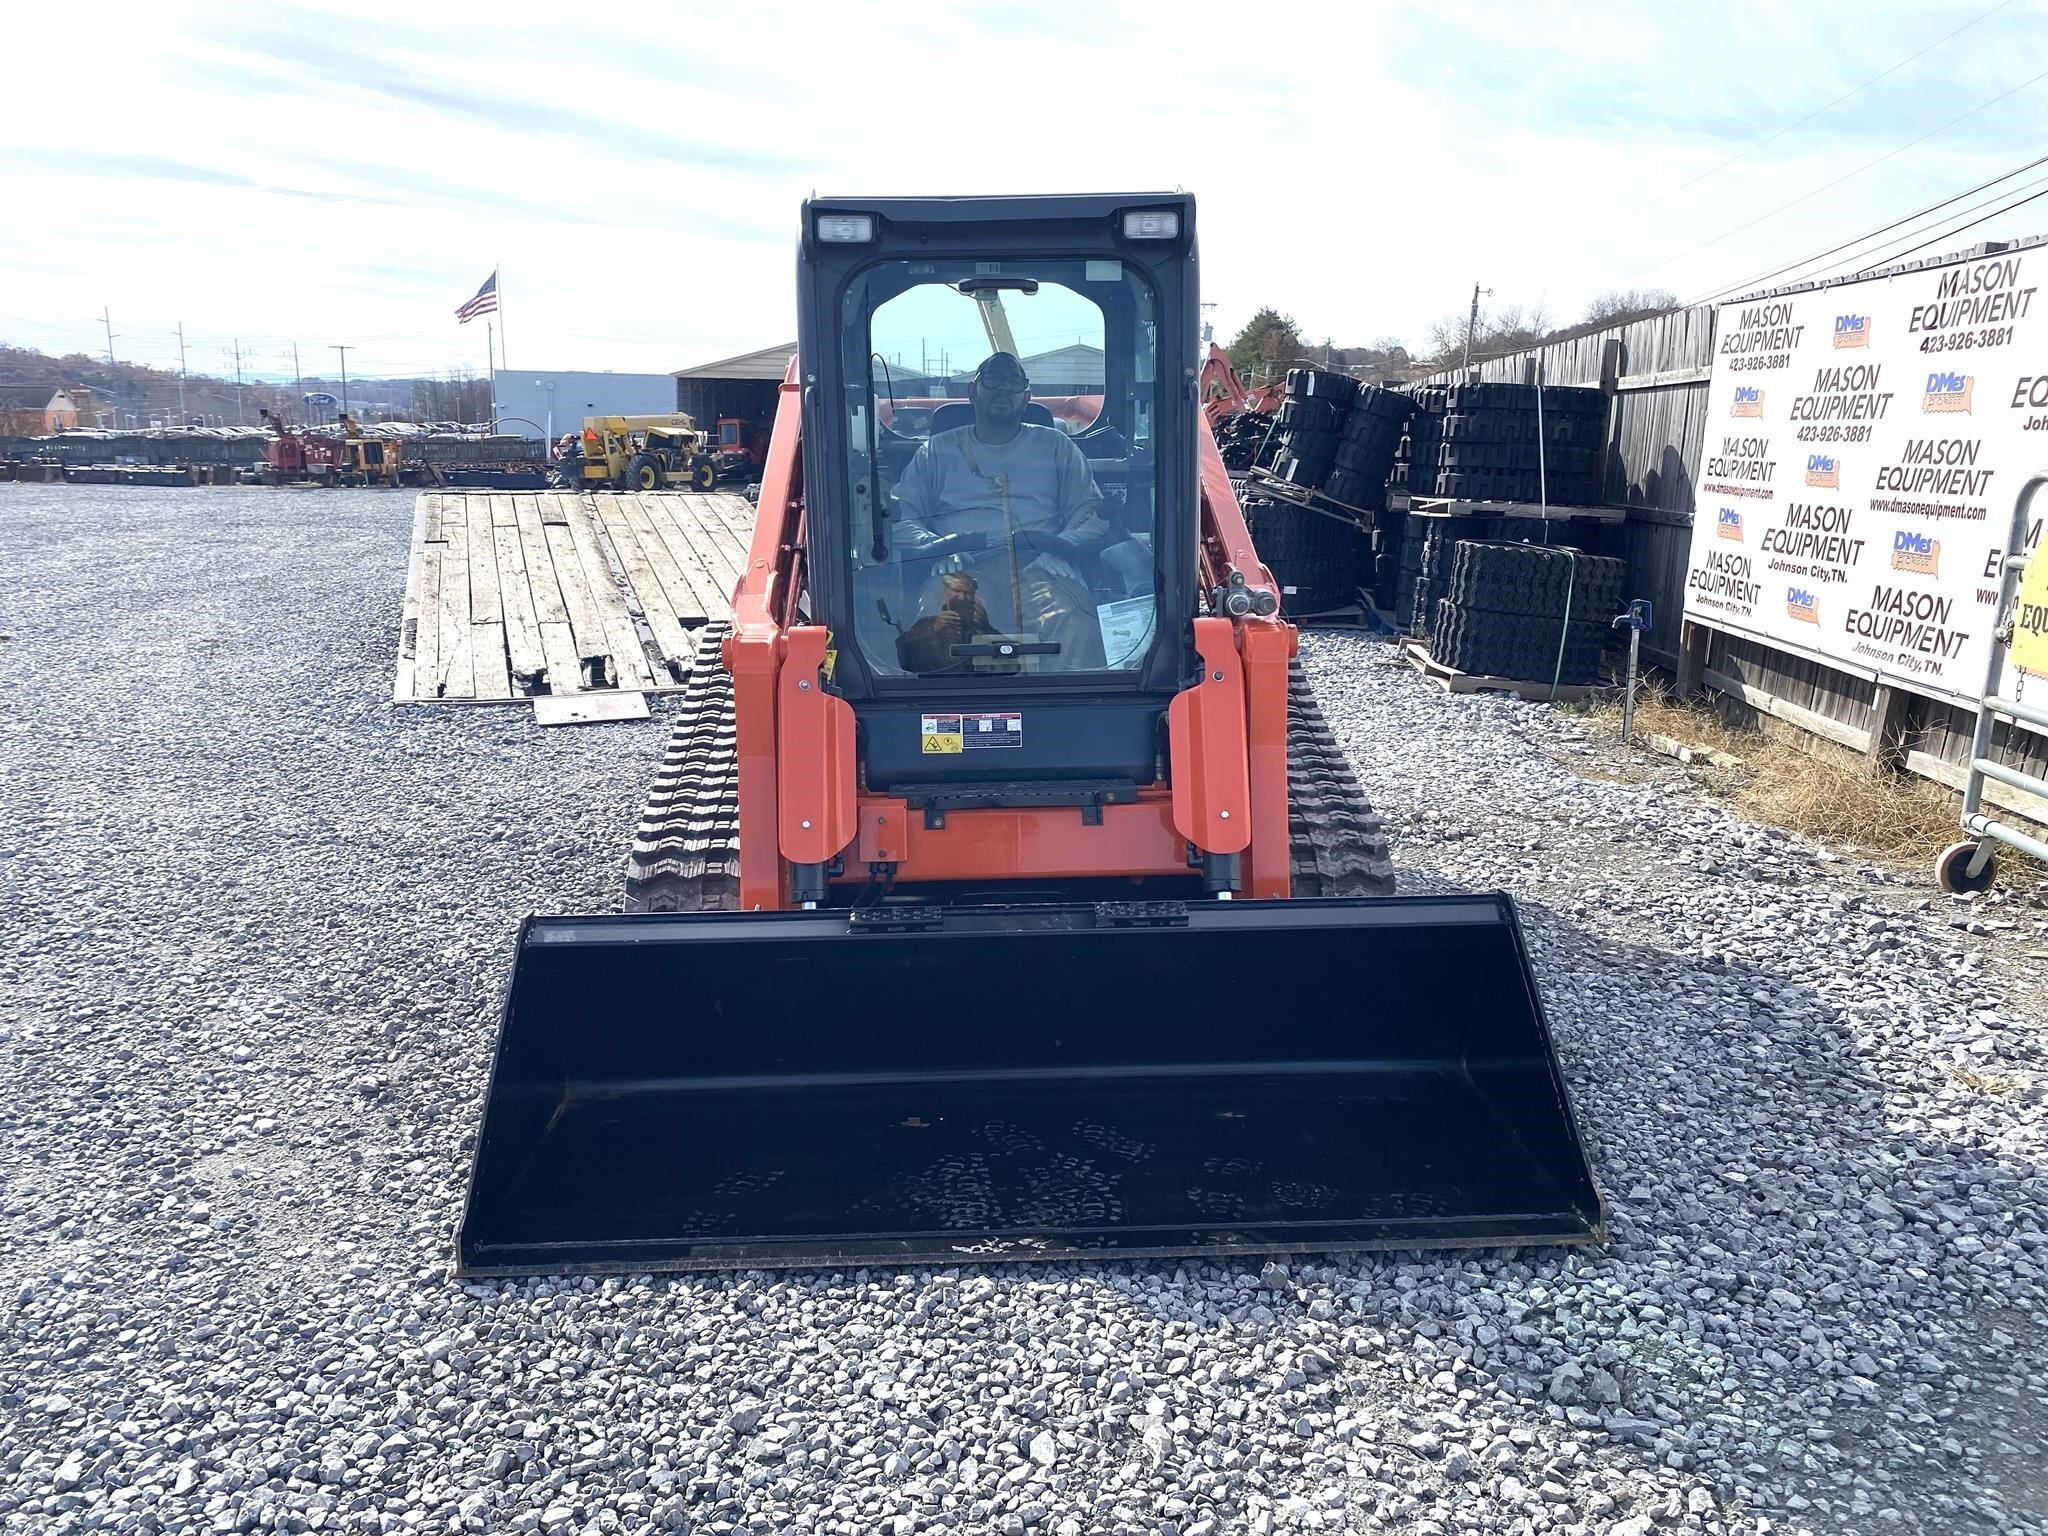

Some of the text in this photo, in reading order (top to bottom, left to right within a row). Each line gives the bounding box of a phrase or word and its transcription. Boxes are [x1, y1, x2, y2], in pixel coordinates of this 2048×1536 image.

[1937, 257, 2022, 300] MASON
[1739, 302, 1793, 331] MASON
[1908, 287, 2038, 333] EQUIPMENT
[1720, 326, 1804, 354] EQUIPMENT
[1920, 325, 2014, 354] 423-926-3881
[1729, 353, 1790, 372] 423-926-3881
[1813, 364, 1881, 393] MASON
[1790, 393, 1894, 421] EQUIPMENT
[1722, 437, 1769, 458] MASON
[1797, 425, 1872, 443] 423-926-3881
[1902, 439, 1981, 466] MASON
[1707, 458, 1776, 482] EQUIPMENT
[1876, 466, 1994, 497] EQUIPMENT
[1785, 503, 1852, 534] MASON
[1870, 497, 1987, 521] www.dmasonequipment.com
[1761, 528, 1865, 566] EQUIPMENT
[1706, 550, 1752, 579] MASON
[1768, 558, 1808, 576] Johnson
[1689, 569, 1761, 605] EQUIPMENT
[1696, 593, 1724, 609] Johnson
[1871, 585, 1953, 625] MASON
[1845, 609, 1970, 659] EQUIPMENT
[1852, 641, 1895, 663] Johnson
